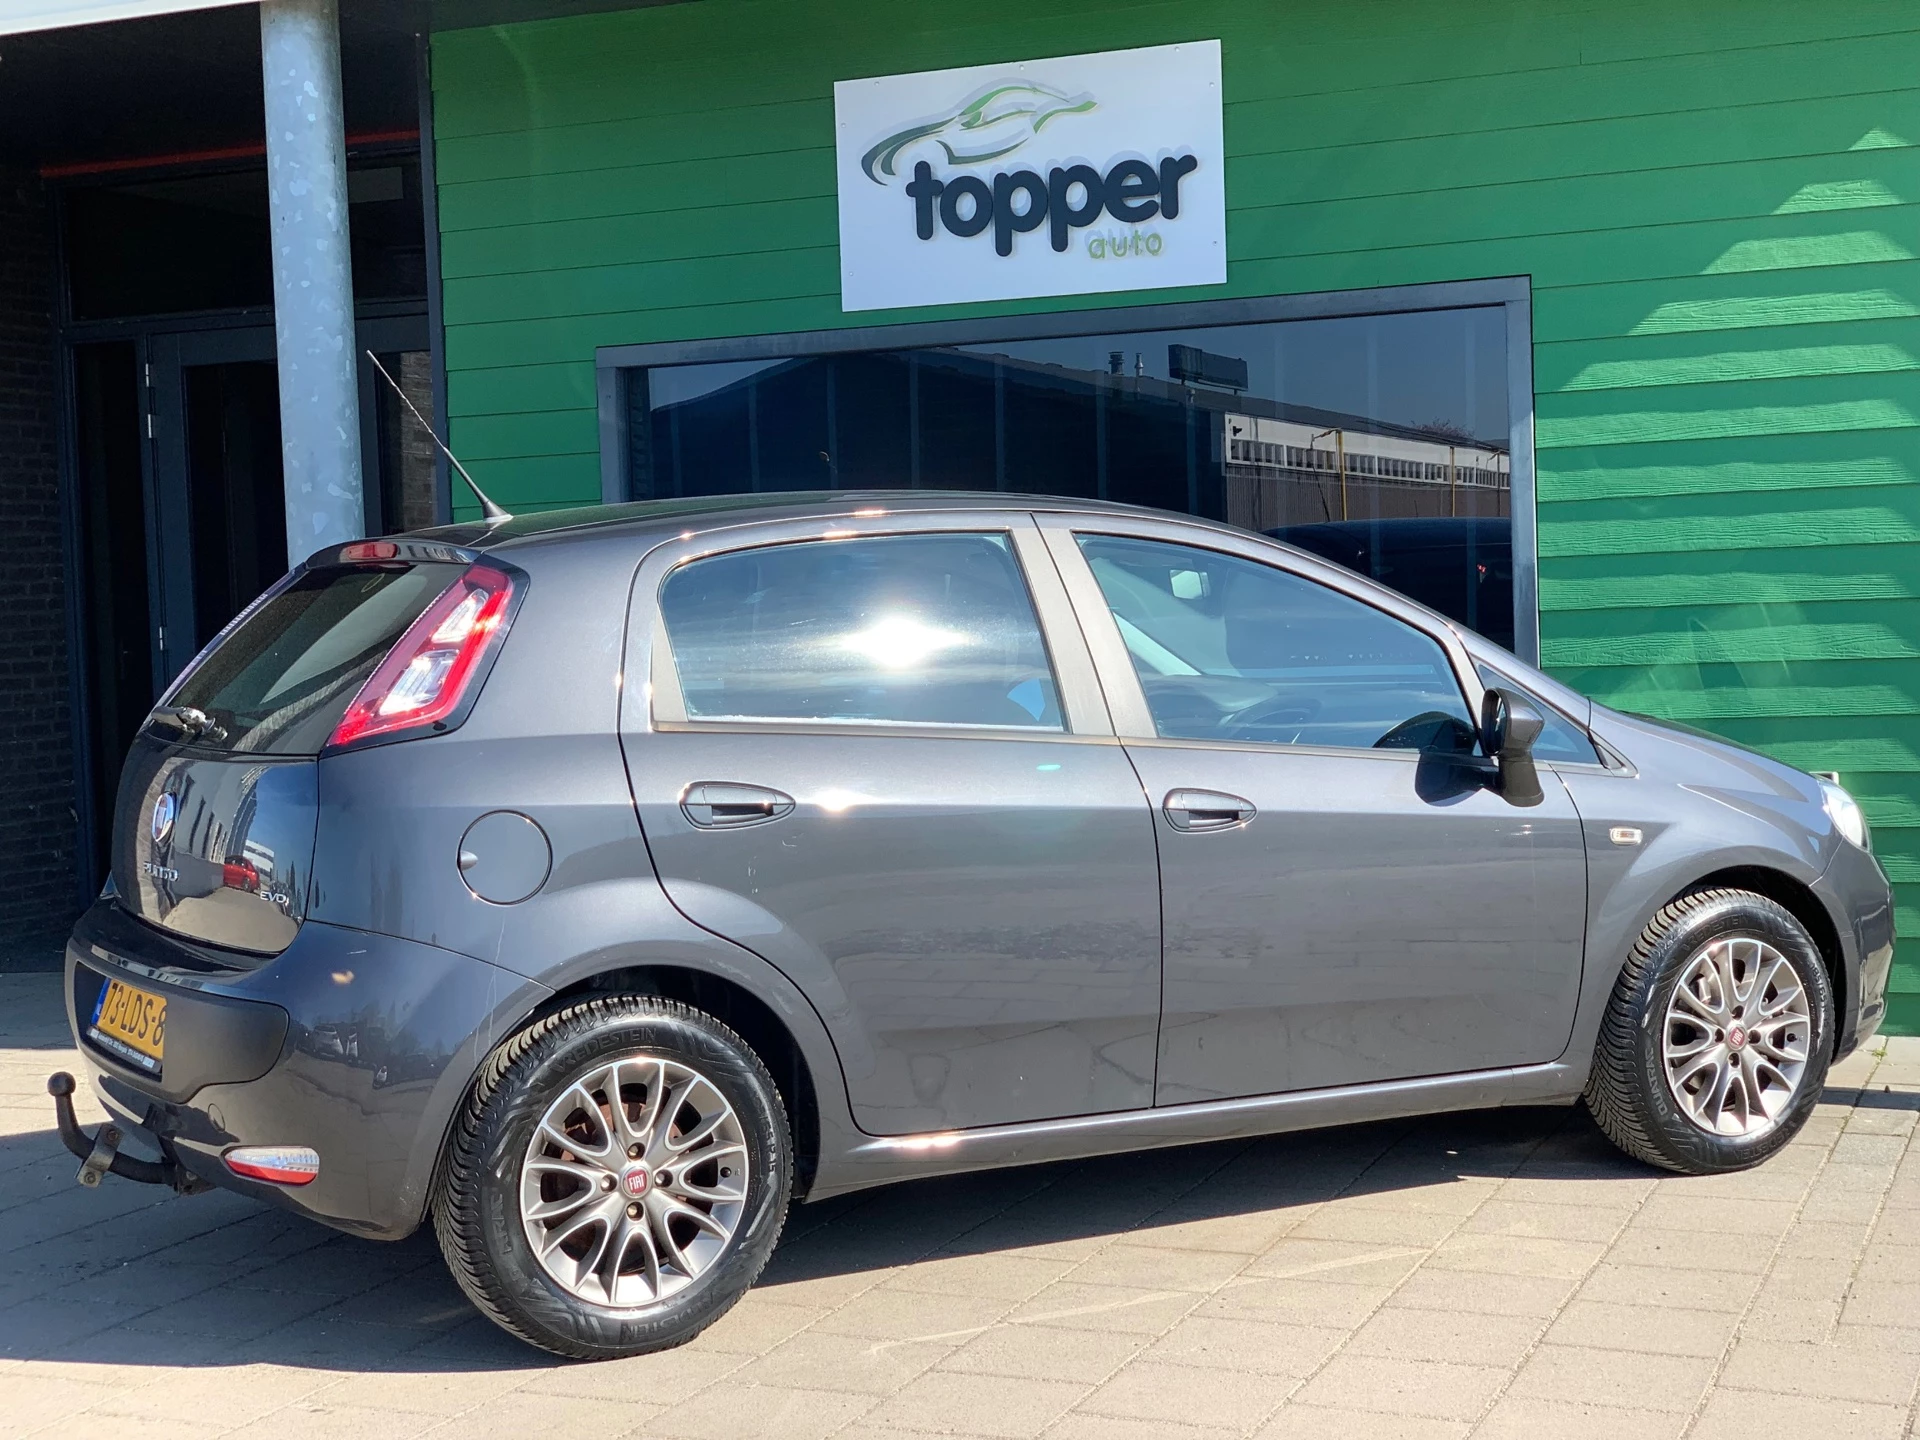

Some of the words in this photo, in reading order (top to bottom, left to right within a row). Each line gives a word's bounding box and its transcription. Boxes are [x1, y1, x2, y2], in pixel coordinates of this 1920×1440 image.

[905, 154, 1197, 257] topper
[1088, 230, 1163, 260] auto
[550, 1026, 658, 1074] VREDESTEIN
[1644, 1047, 1669, 1117] QUATRAC
[628, 1173, 645, 1191] FIAT
